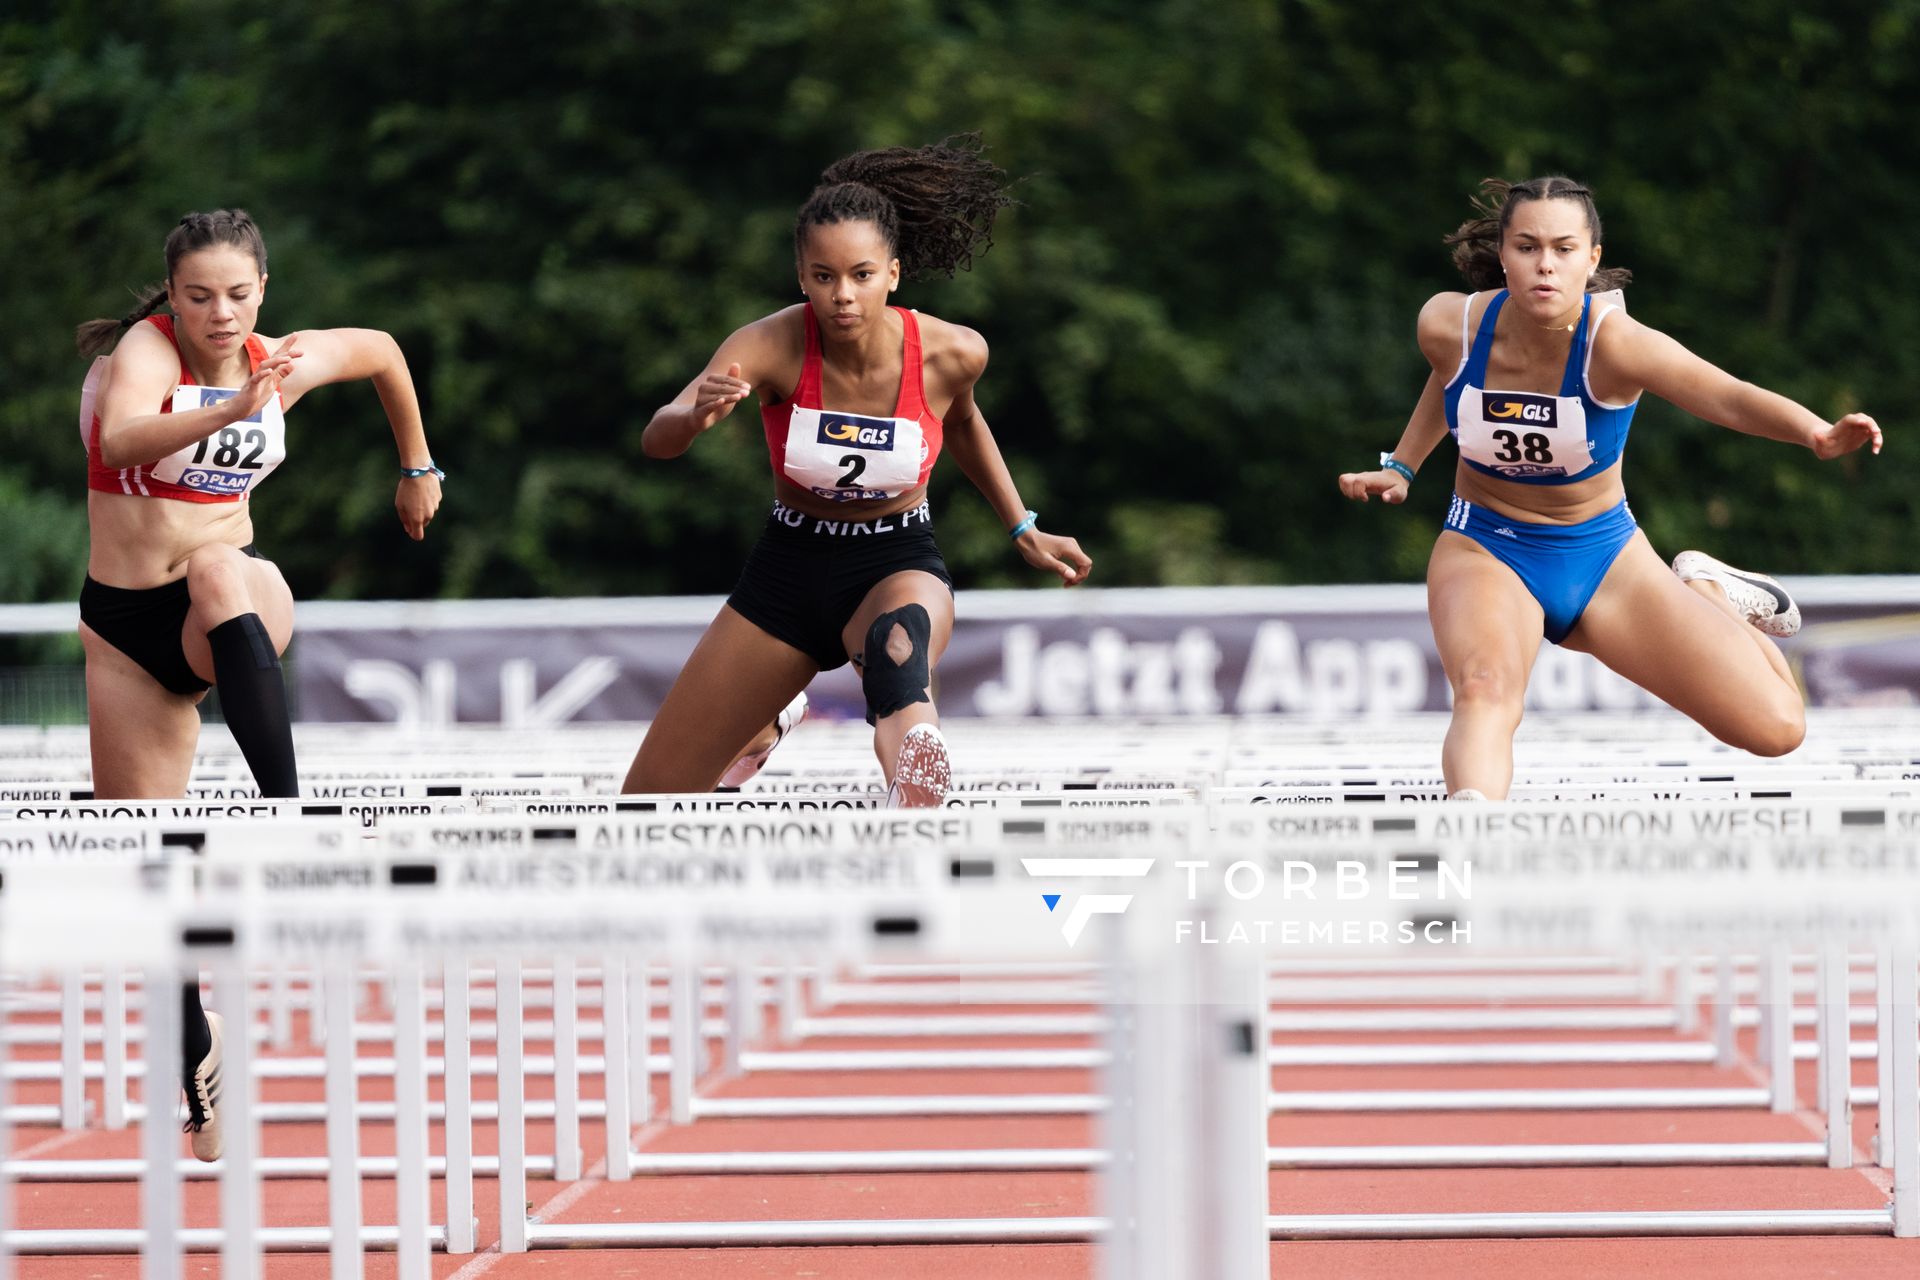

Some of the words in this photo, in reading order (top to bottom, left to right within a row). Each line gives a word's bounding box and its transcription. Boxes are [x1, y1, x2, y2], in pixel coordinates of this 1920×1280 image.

[1522, 404, 1551, 421] GLS
[191, 427, 266, 469] 182
[858, 427, 889, 445] GLS
[1492, 429, 1553, 463] 38
[209, 474, 249, 487] PLAN
[836, 454, 866, 488] 2
[975, 623, 1218, 716] Jetzt
[1238, 620, 1428, 718] App
[49, 830, 146, 856] Wesel
